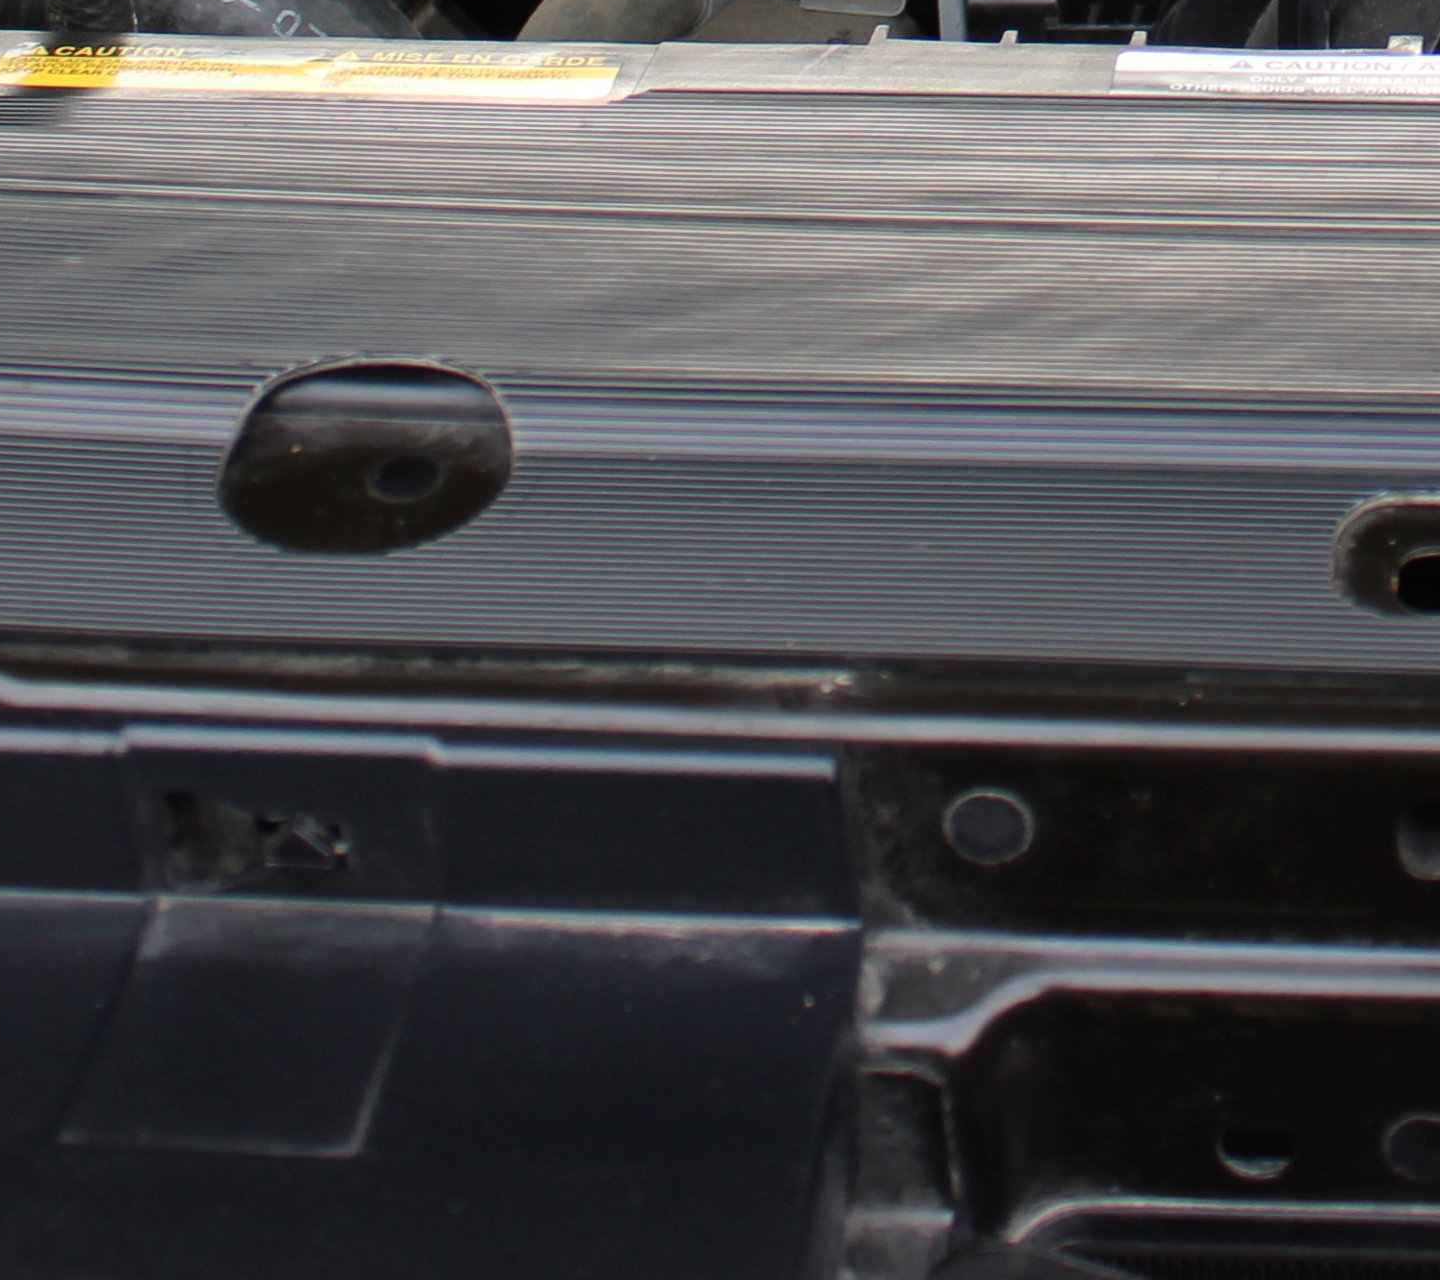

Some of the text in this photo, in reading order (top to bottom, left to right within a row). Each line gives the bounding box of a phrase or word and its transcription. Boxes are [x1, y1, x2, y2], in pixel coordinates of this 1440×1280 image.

[54, 45, 185, 57] CAUTION
[372, 52, 607, 67] MISE EN GARDE
[1264, 59, 1393, 72] CAUTION
[1249, 75, 1298, 84] ONLY
[1349, 76, 1418, 86] NISSAN
[1169, 83, 1232, 92] OTHER
